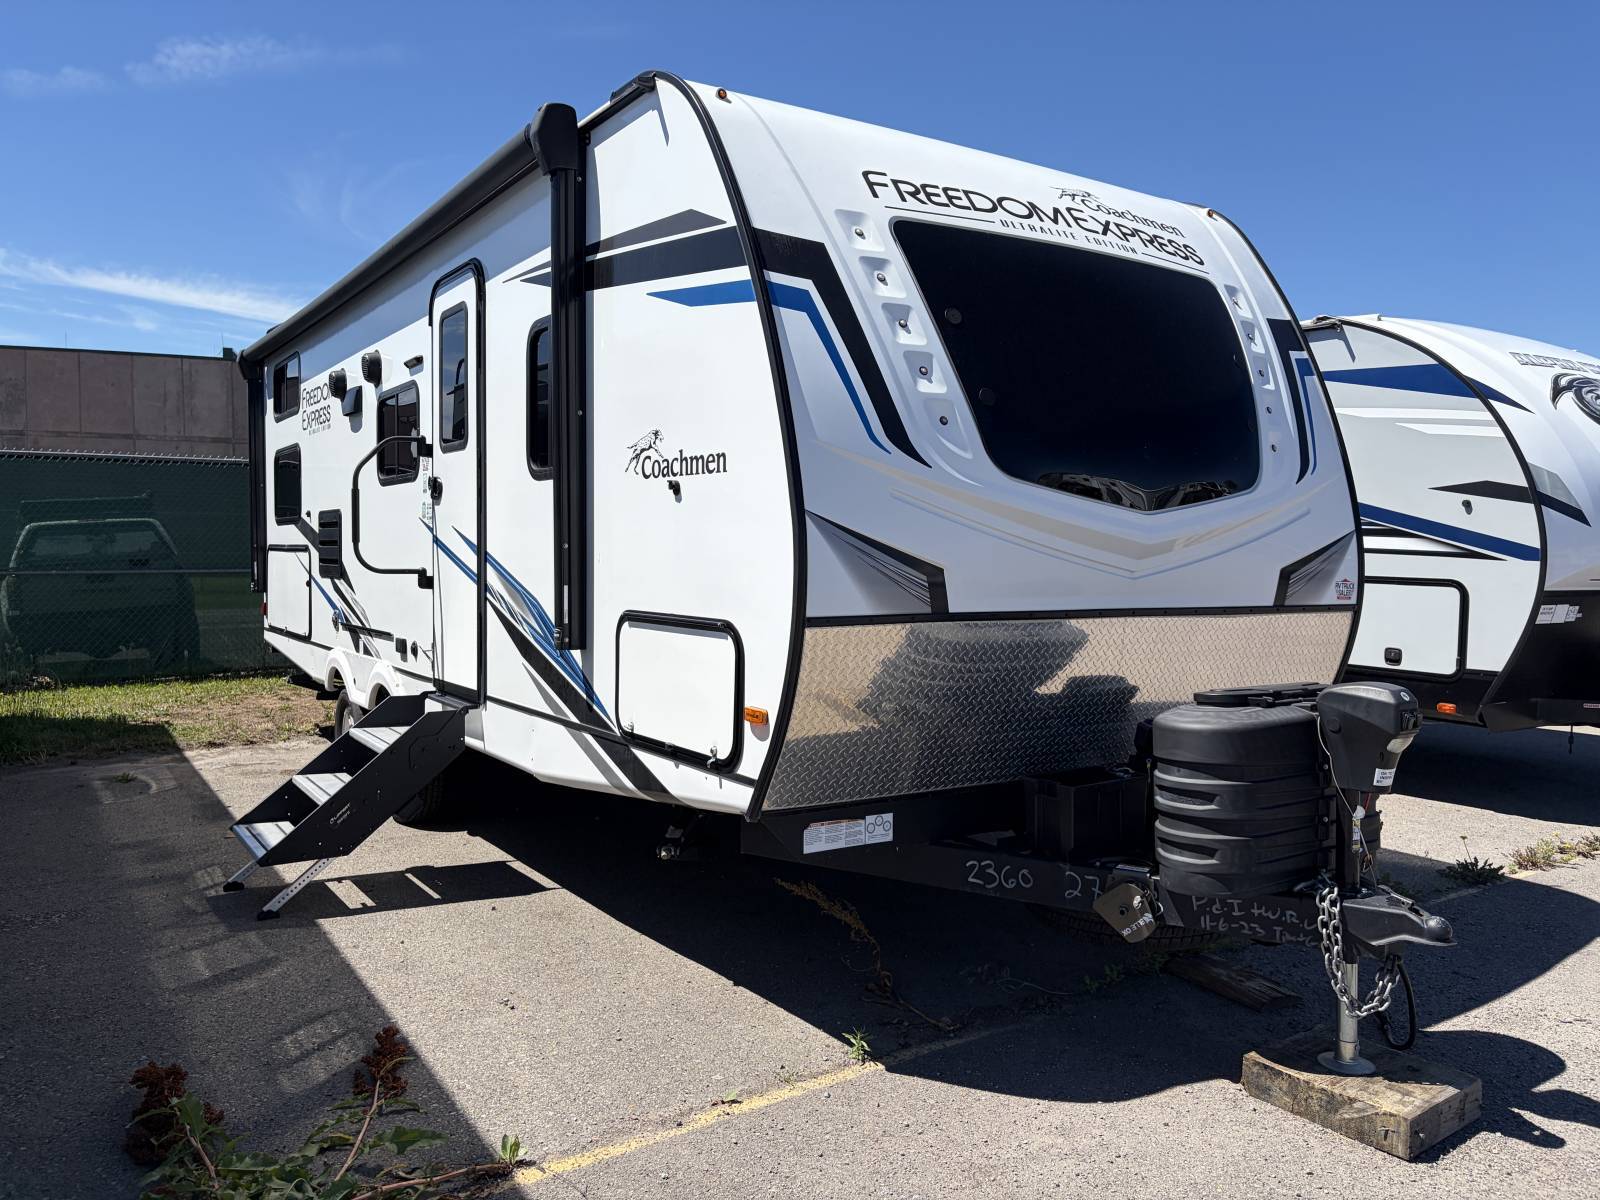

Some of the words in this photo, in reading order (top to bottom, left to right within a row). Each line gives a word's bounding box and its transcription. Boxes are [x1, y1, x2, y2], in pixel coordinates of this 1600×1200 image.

[1080, 198, 1186, 238] Coachmen
[999, 219, 1079, 241] ULTRALITE
[1086, 235, 1138, 255] EDITION
[301, 382, 331, 410] FREEDO
[301, 404, 331, 431] EXPRESS
[641, 448, 728, 480] Coachmen
[965, 860, 1034, 889] 2360
